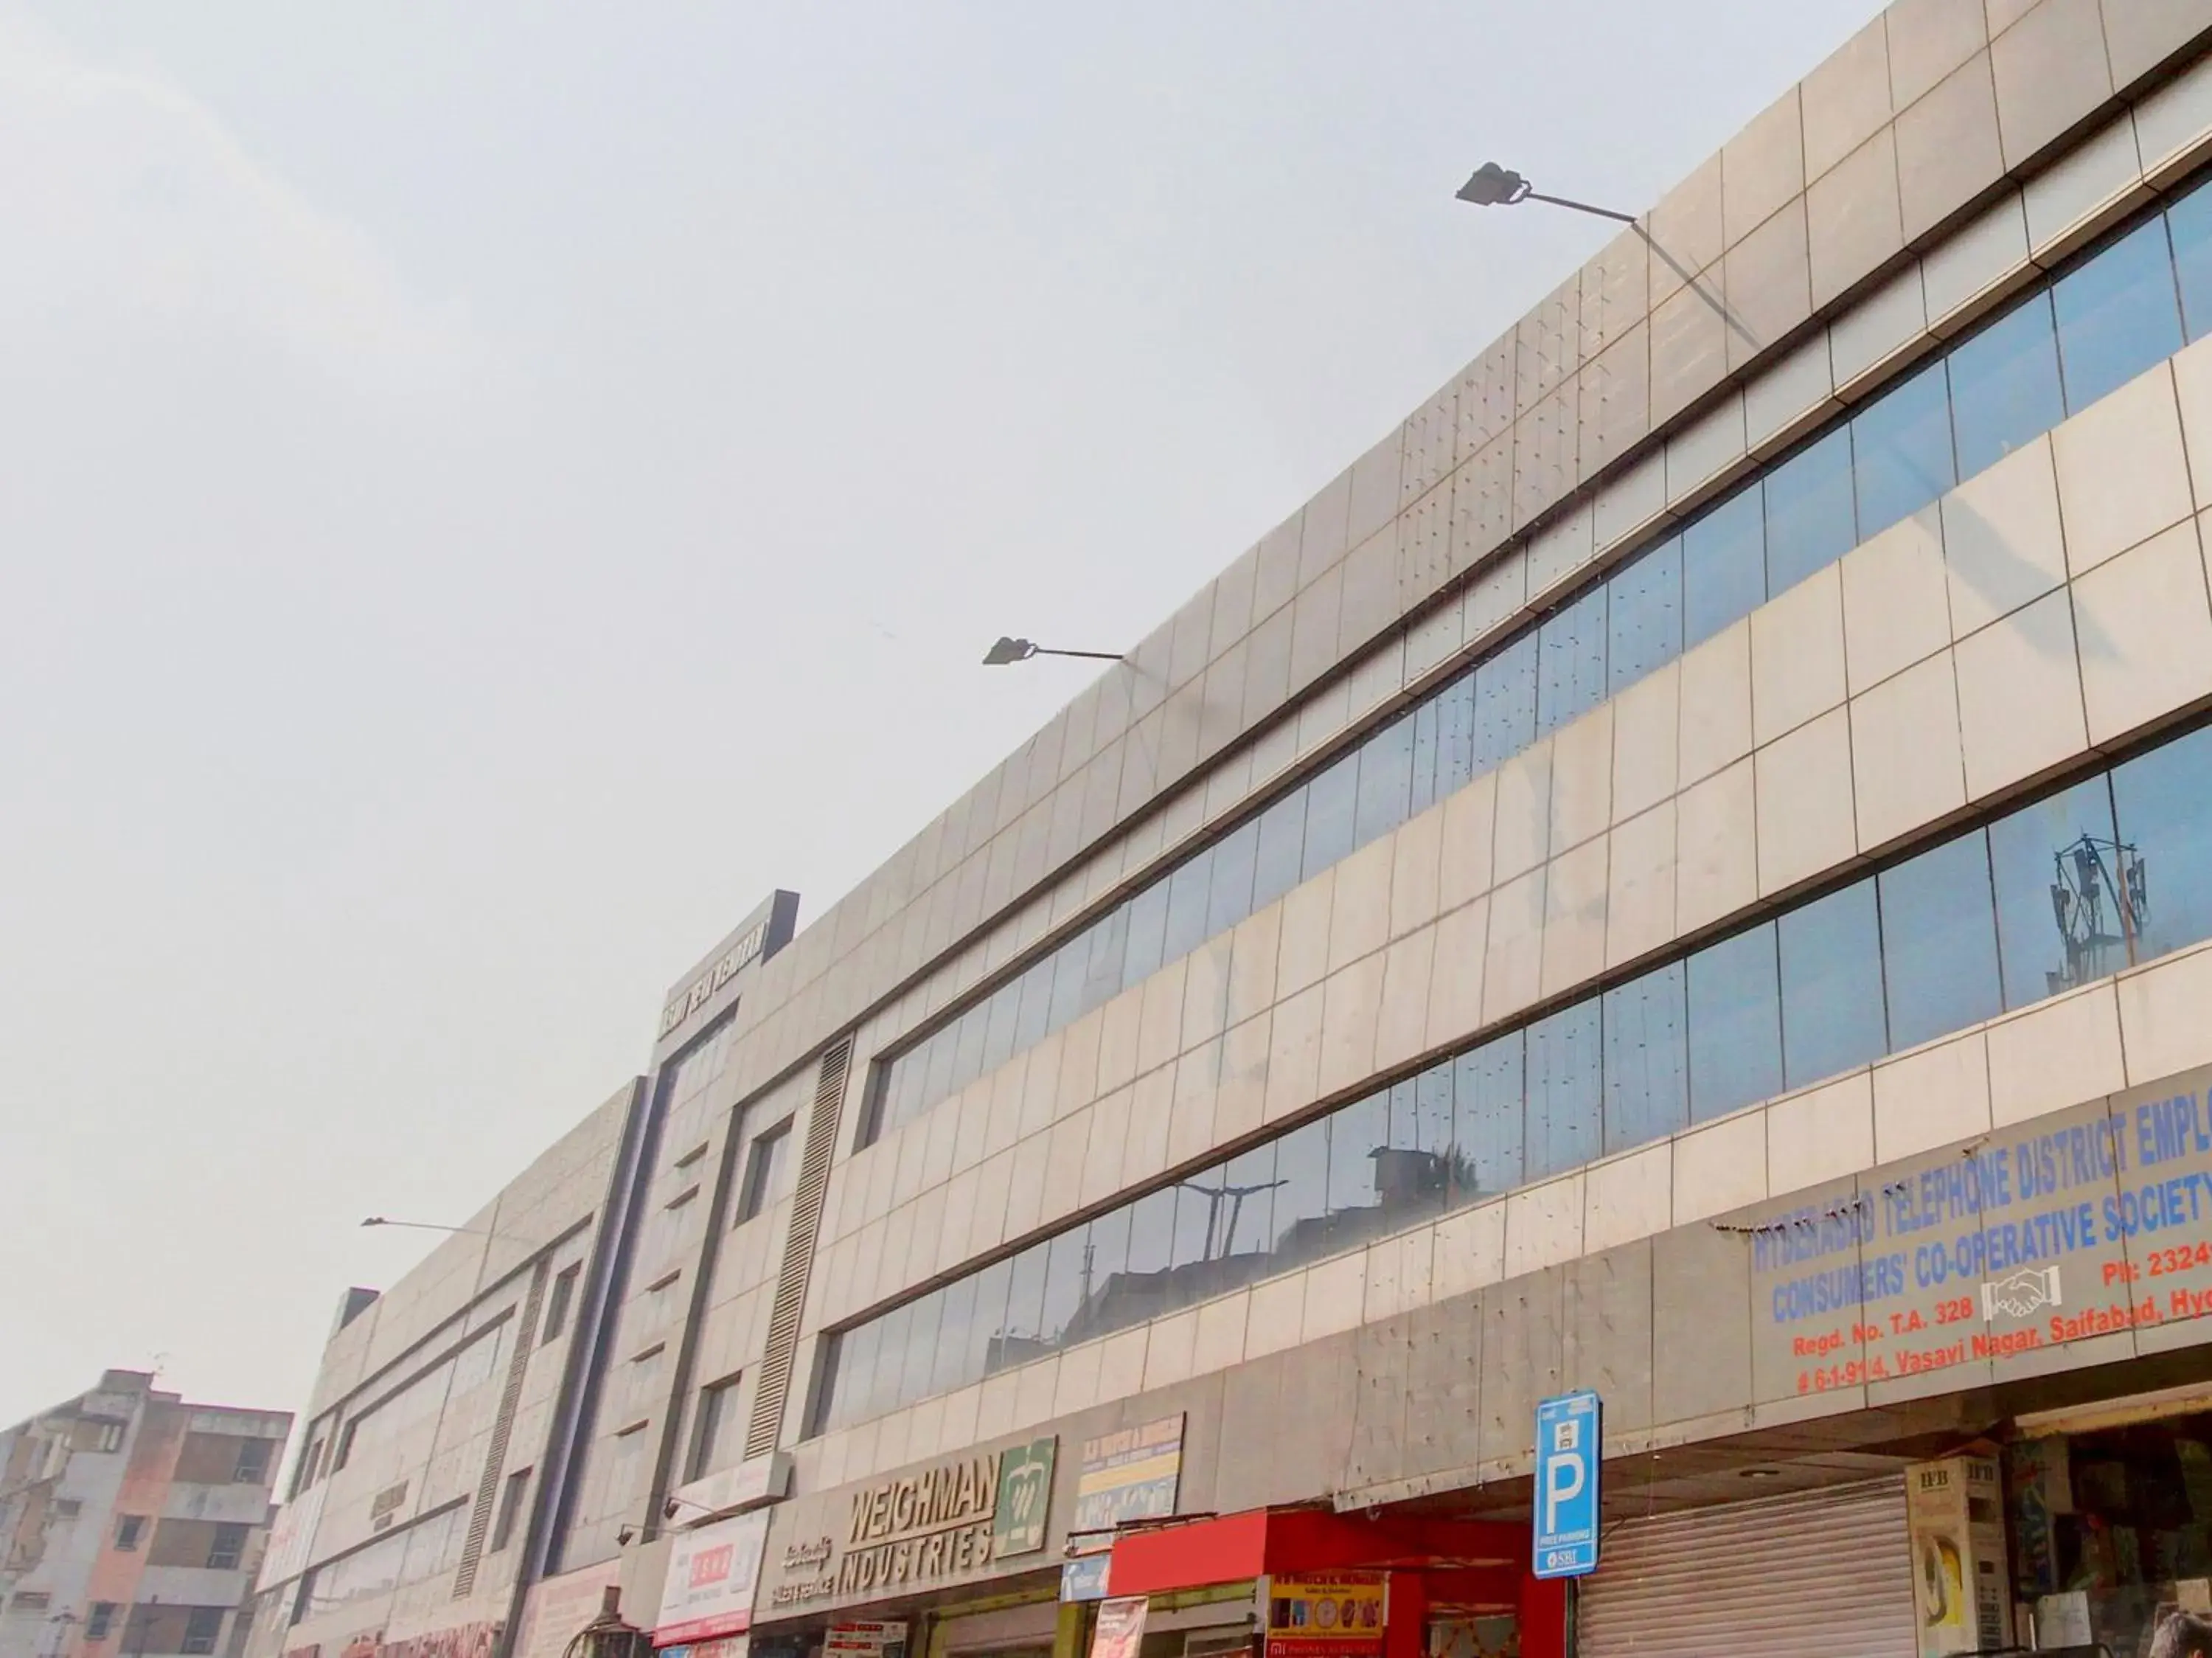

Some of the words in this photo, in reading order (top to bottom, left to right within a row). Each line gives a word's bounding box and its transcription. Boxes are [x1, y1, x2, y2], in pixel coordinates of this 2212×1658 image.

[1882, 1148, 2011, 1237] TELEPHONE
[2017, 1112, 2127, 1201] DISTRICT
[1915, 1202, 2096, 1287] CO-OPERATIVE
[2147, 1241, 2212, 1277] 2324
[1792, 1329, 1845, 1358] Regd.
[1851, 1323, 1884, 1344] No.
[1889, 1310, 1927, 1335] T.A.
[1934, 1297, 1974, 1325] 328
[1895, 1337, 1964, 1374] Vasavi
[849, 1452, 1004, 1544] WEIGHMAN
[1547, 1453, 1585, 1534] P
[837, 1524, 994, 1595] INDUSTRIES
